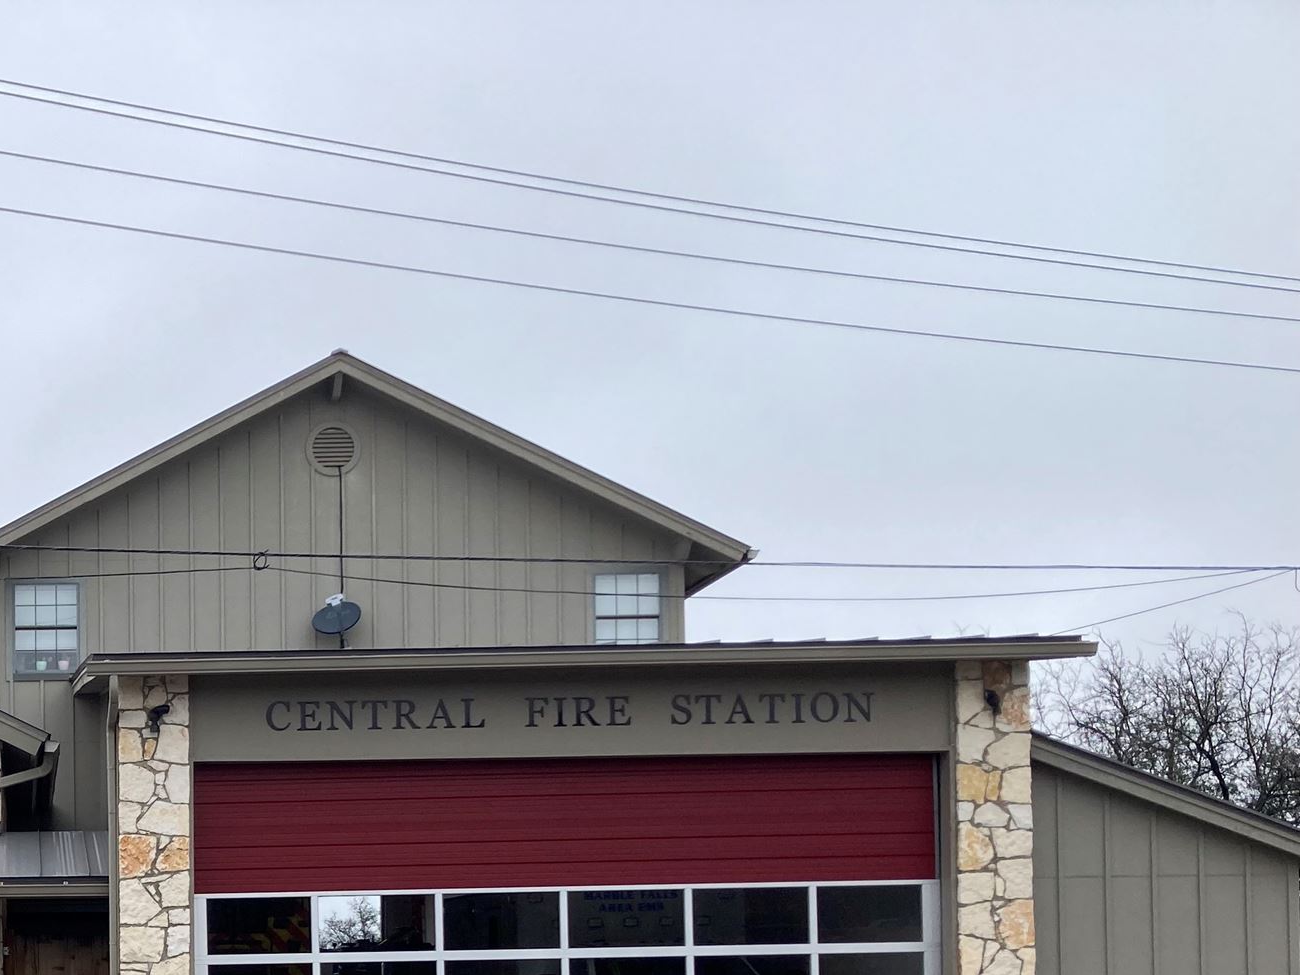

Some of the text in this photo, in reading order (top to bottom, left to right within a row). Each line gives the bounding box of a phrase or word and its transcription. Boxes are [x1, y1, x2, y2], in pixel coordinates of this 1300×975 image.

[265, 692, 875, 731] CENTRAL FIRE STATION
